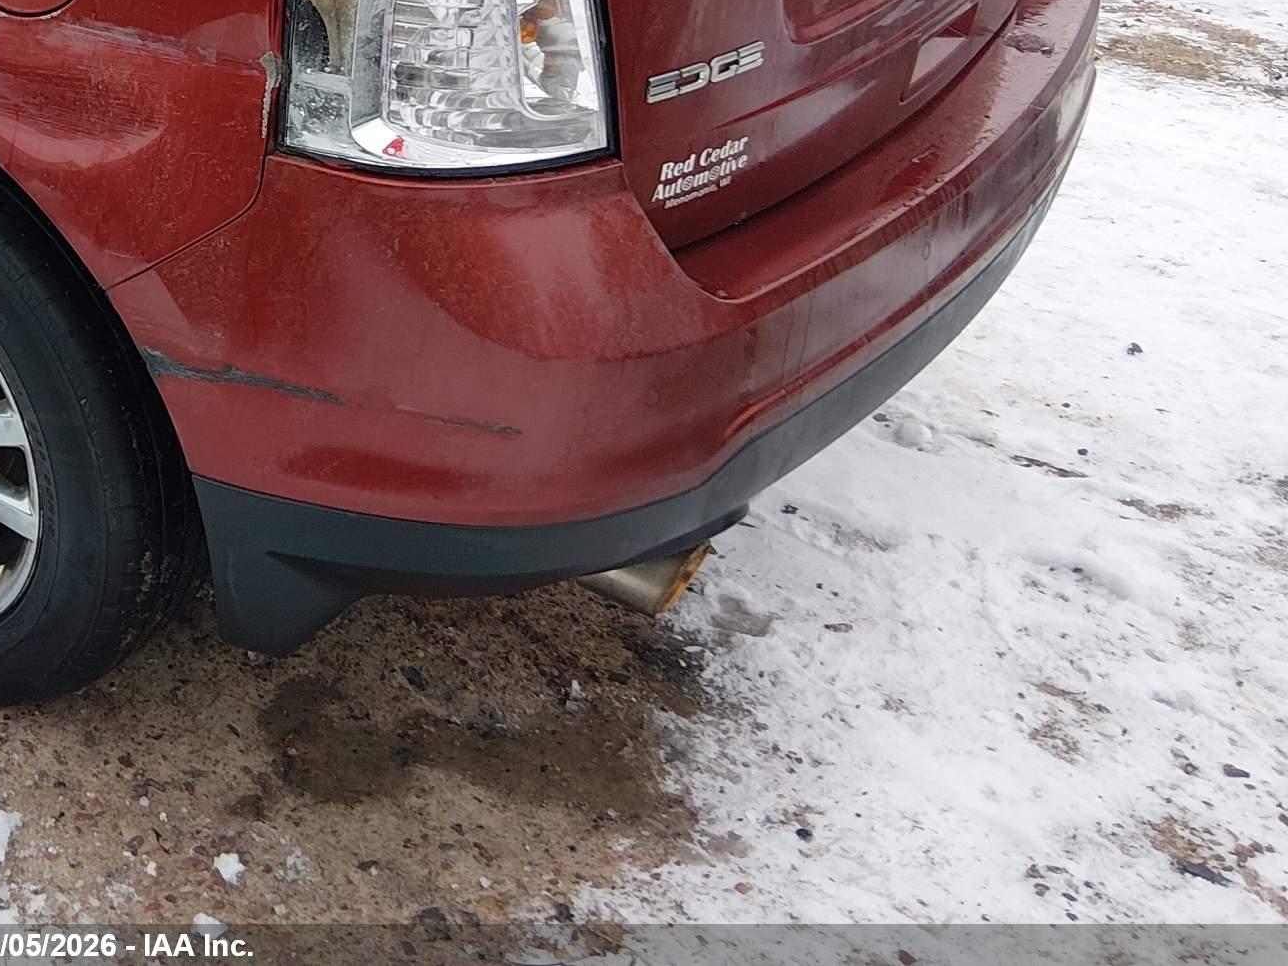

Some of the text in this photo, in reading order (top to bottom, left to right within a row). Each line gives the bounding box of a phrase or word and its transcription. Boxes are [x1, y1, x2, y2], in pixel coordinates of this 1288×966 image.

[646, 41, 766, 104] EDGE
[651, 154, 749, 203] Automotive
[660, 136, 749, 182] Red Cedar
